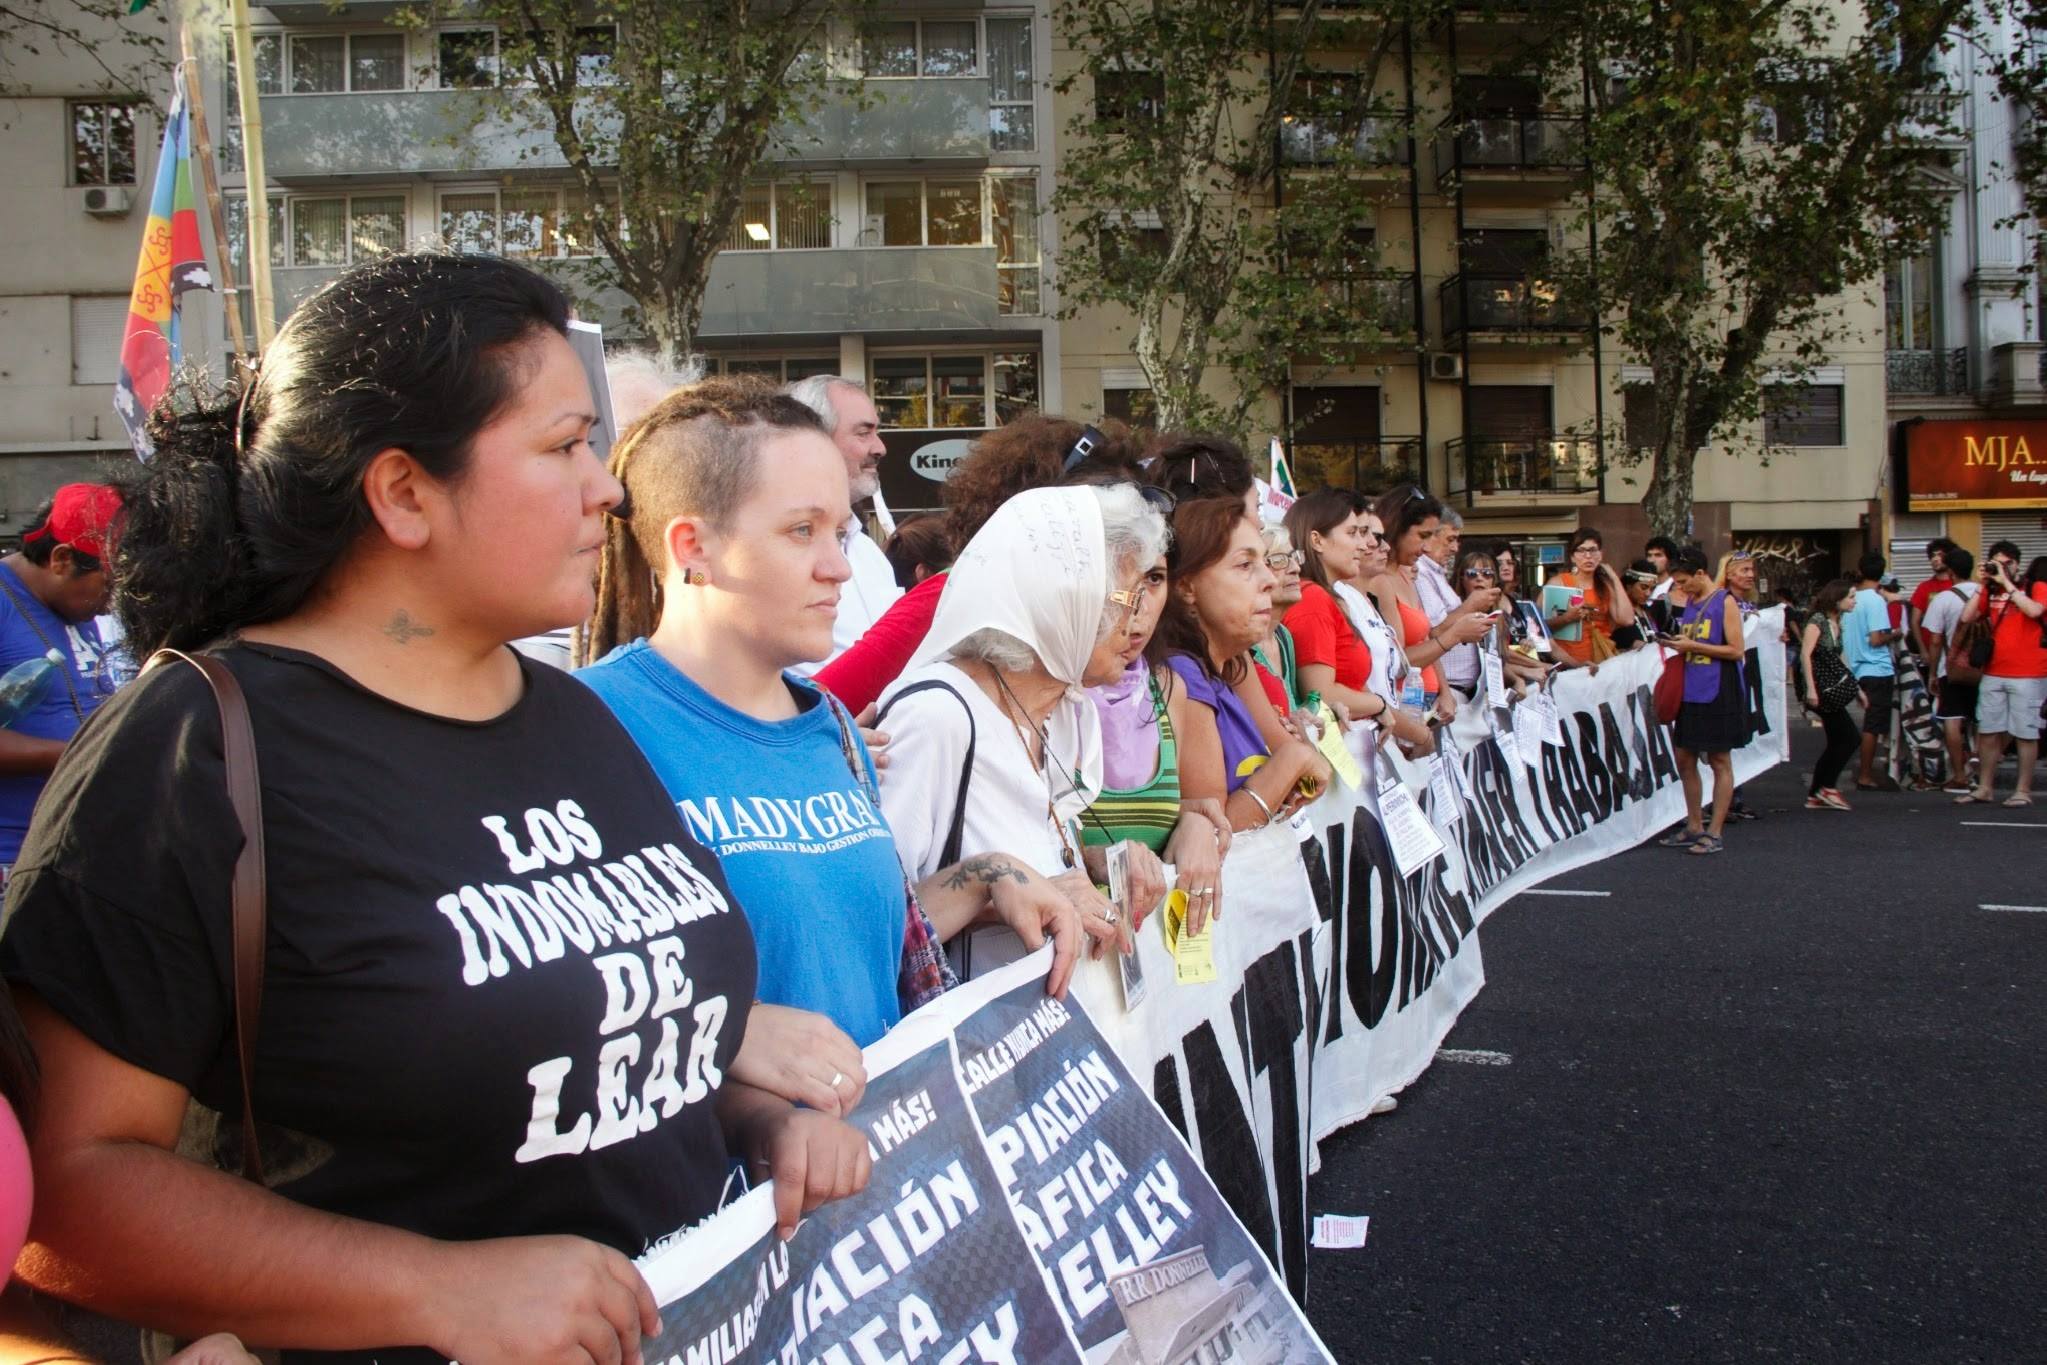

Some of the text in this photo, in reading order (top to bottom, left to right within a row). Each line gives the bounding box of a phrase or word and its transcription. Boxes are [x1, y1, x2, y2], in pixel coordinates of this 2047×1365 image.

[481, 799, 602, 874] LOS
[720, 840, 797, 856] DONNELLEY
[798, 843, 826, 855] BAJO
[825, 830, 870, 851] GESTION
[436, 843, 729, 986] INDOMABLES
[593, 936, 693, 1035] DE
[1033, 997, 1072, 1037] MÁS!
[515, 995, 729, 1163] LEAR
[872, 1089, 937, 1153] MÁS!
